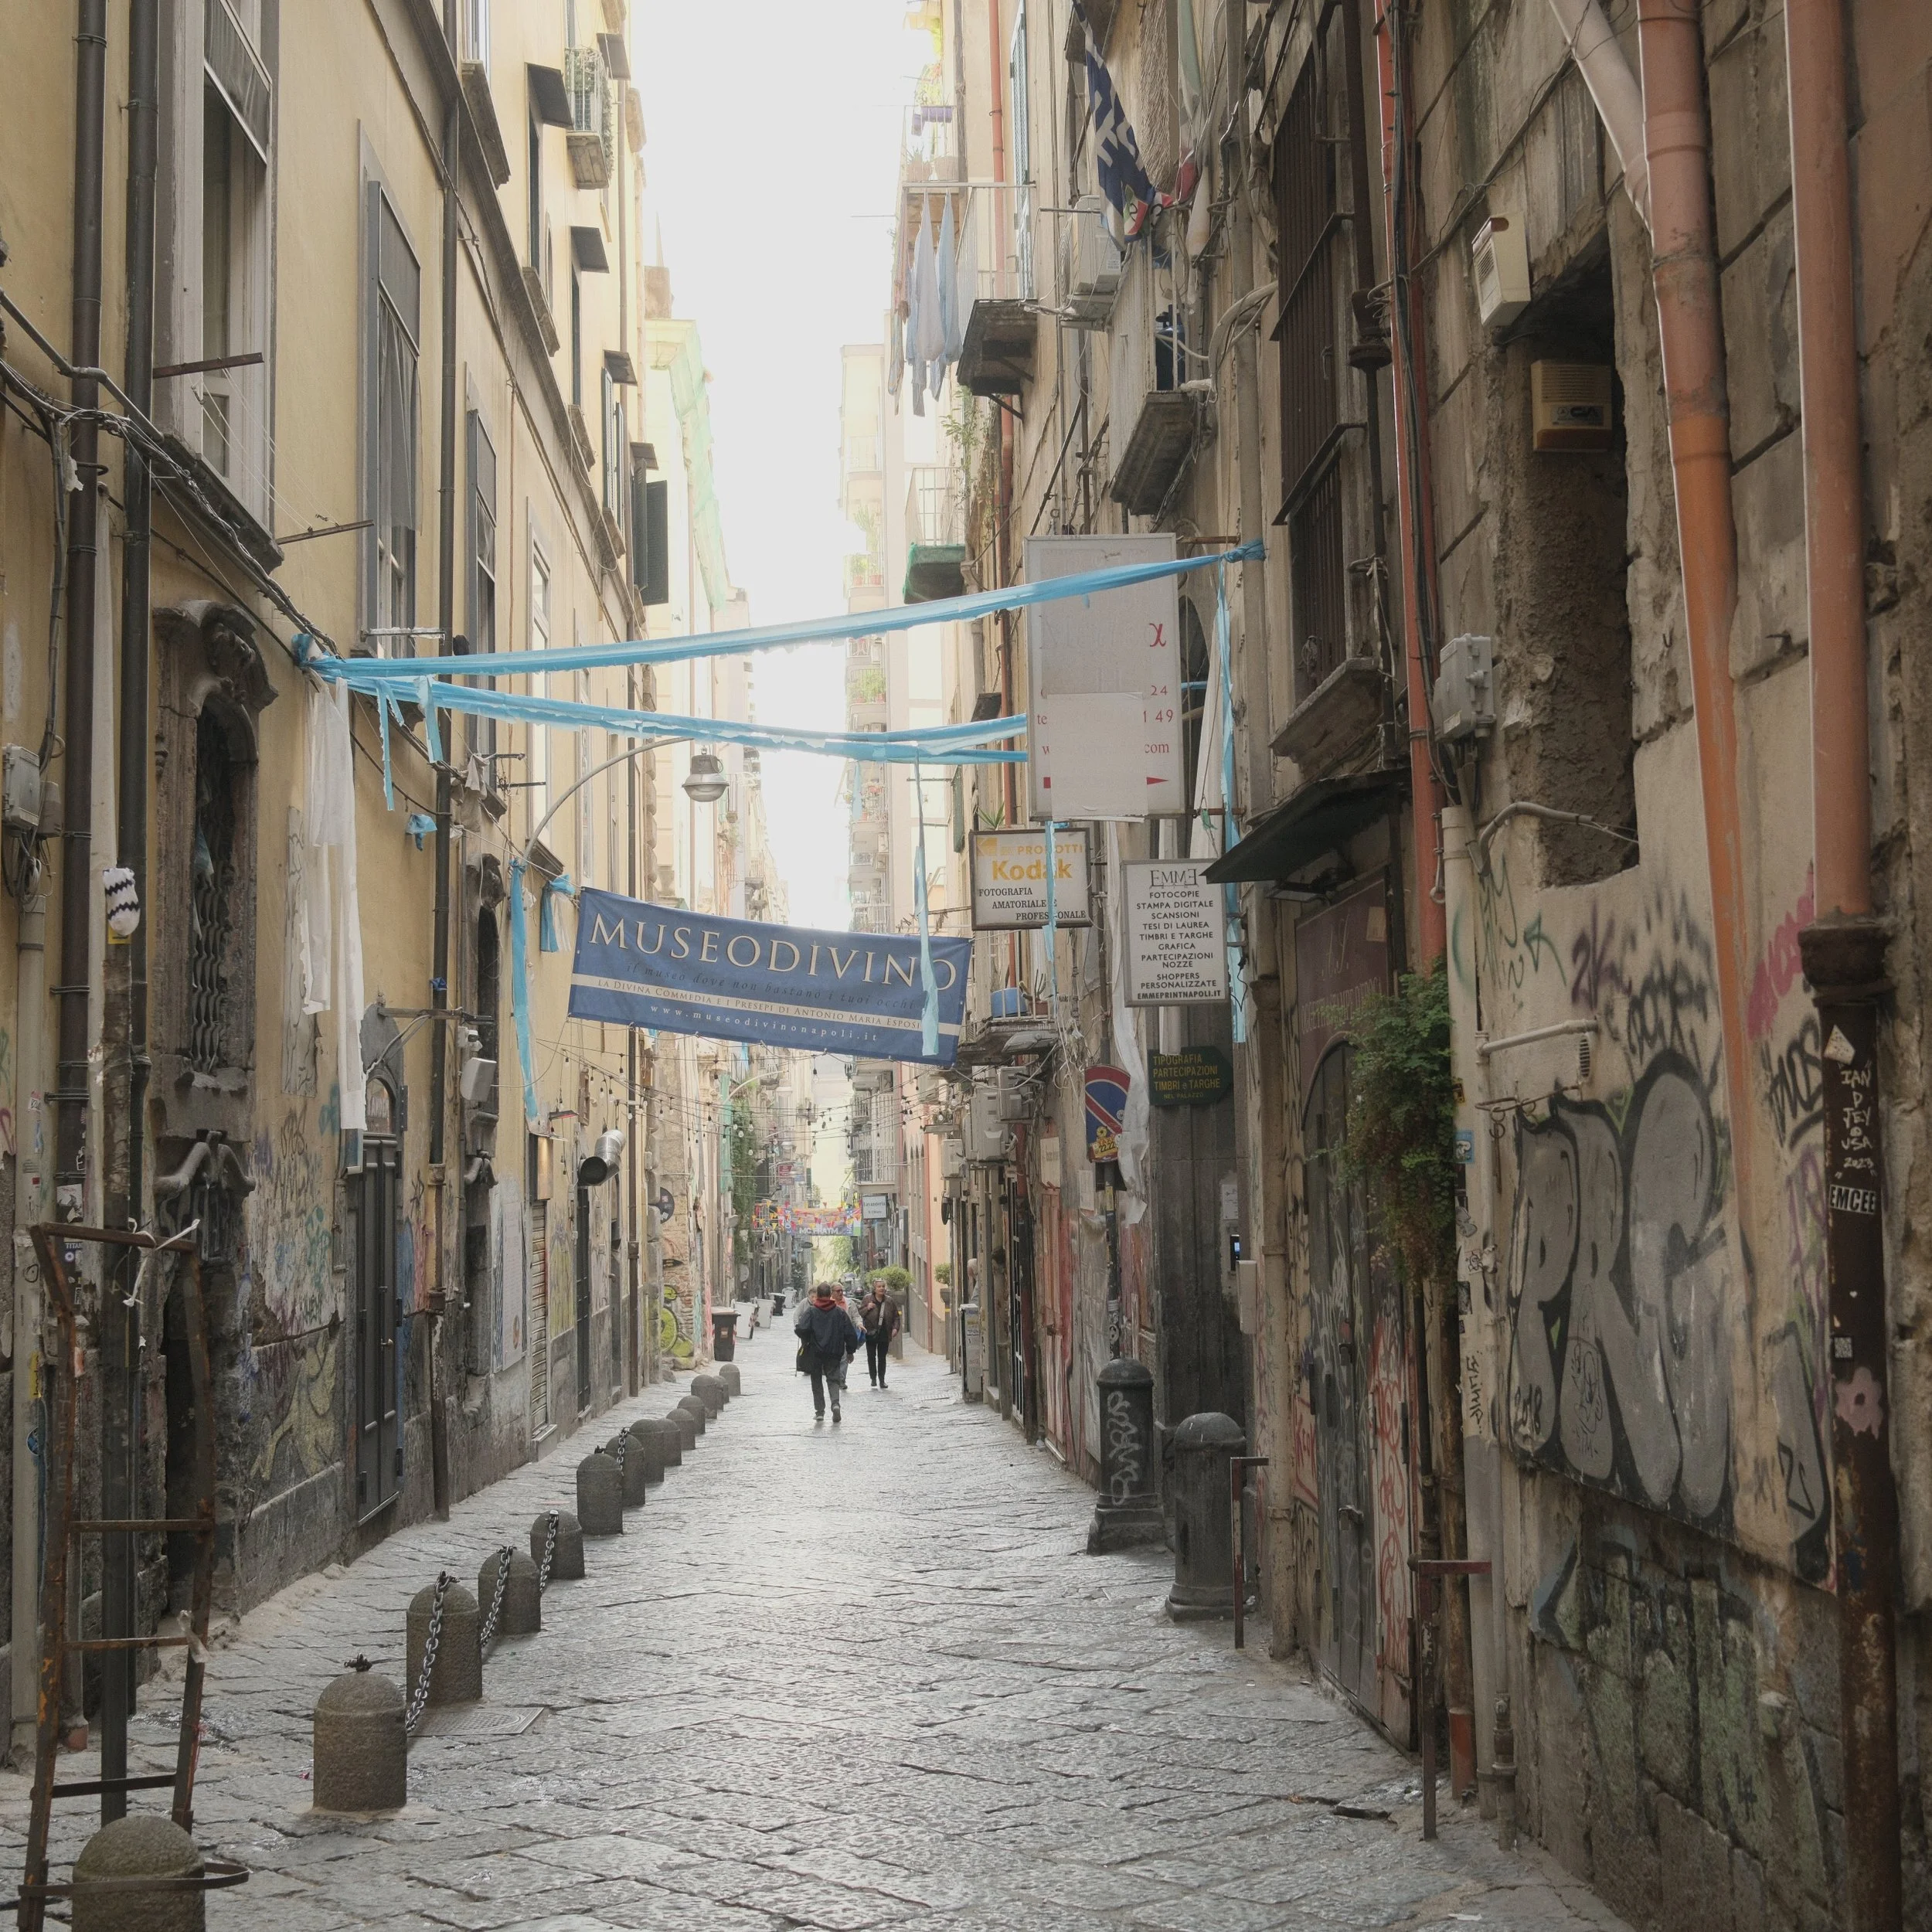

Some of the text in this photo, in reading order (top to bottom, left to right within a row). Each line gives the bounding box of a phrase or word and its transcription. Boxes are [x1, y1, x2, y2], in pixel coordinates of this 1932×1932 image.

[1037, 713, 1048, 725] te
[1017, 844, 1083, 855] PROOTTI
[979, 887, 1033, 897] FOTOGRAFIA
[1150, 890, 1199, 899] FOTOCOPIE
[992, 900, 1046, 910] AMATORIALE
[1174, 900, 1213, 909] DIGITALE
[1016, 910, 1087, 920] PROFESONALE
[1151, 911, 1199, 920] SCANSIONI
[1158, 942, 1196, 951] GRAFICA
[1141, 952, 1213, 961] PARTECIPAZIONI
[1141, 980, 1216, 989] PERSONALIZZATE
[1138, 990, 1221, 1000] EMMEPRINTNAPOLI.IT
[597, 978, 609, 988] LA
[614, 980, 651, 995] DIVINA
[655, 988, 712, 1004] COMMEDIA
[735, 999, 774, 1012] PRESEPI
[778, 1005, 790, 1014] DI
[794, 1007, 844, 1021] ANTONIO
[849, 1014, 882, 1026] MARIA
[887, 1019, 921, 1029] ESPOSI
[650, 1005, 877, 1042] www.museodivinonapoli.it
[1153, 1053, 1202, 1066] TIPOGRAFIA
[1153, 1065, 1218, 1077] PARTECIPAZIONI
[1154, 1080, 1180, 1091] TIMBRI
[1189, 1078, 1220, 1090] TARGHE
[1841, 1136, 1872, 1151] USA
[1830, 1185, 1876, 1214] EMCEE
